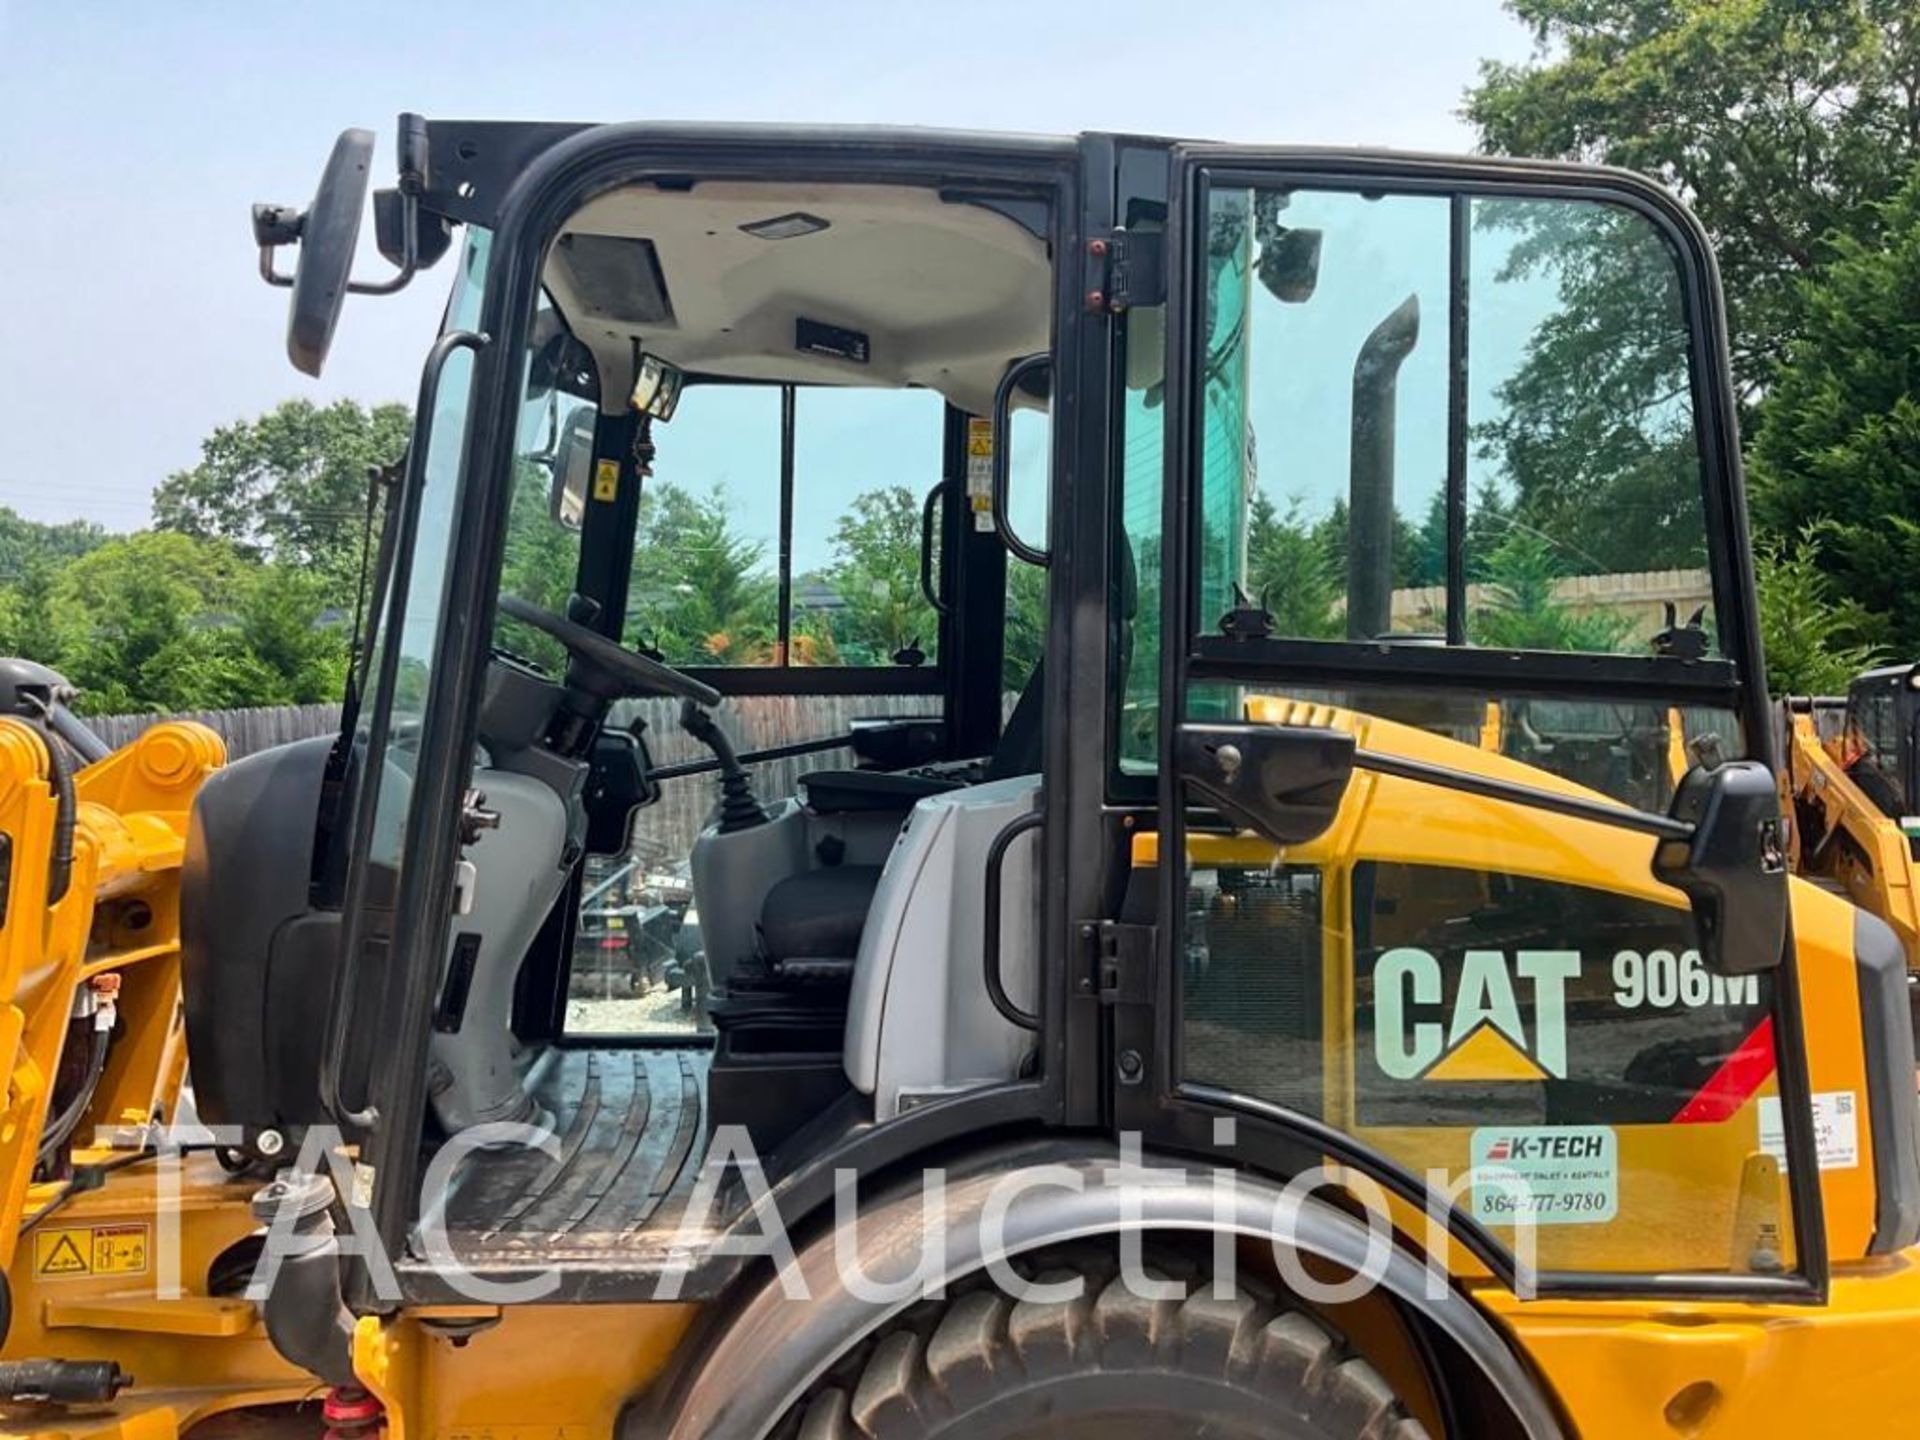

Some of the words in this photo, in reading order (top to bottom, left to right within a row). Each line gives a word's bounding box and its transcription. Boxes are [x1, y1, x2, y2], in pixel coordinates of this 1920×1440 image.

[1612, 950, 1759, 1008] 906M
[1374, 948, 1581, 1079] CAT
[1511, 1136, 1602, 1158] K-TECH
[1483, 1192, 1606, 1213] 864-777-9780
